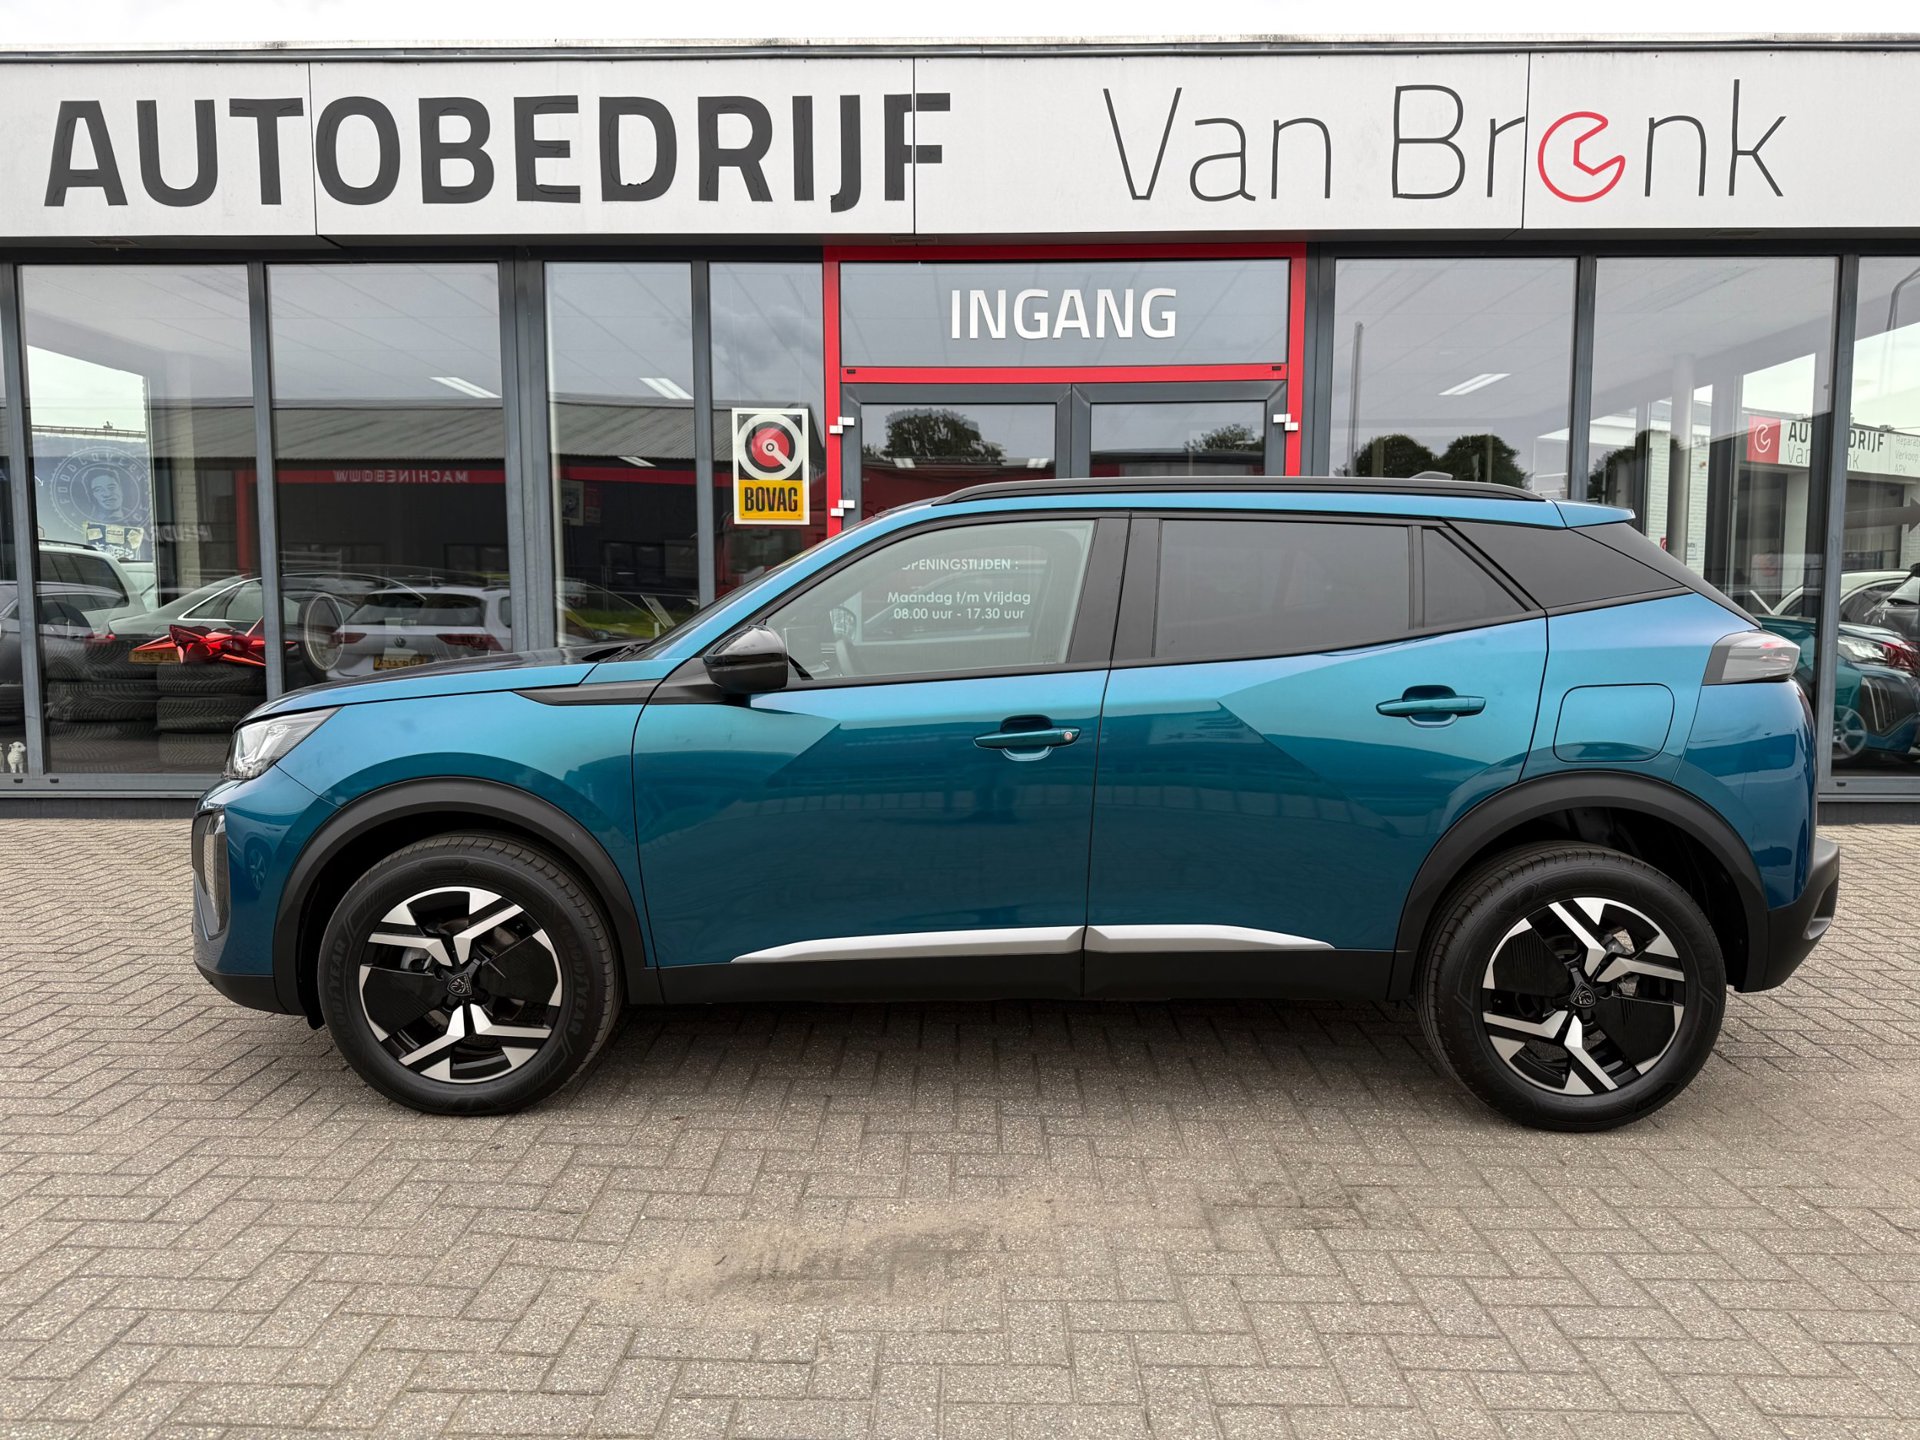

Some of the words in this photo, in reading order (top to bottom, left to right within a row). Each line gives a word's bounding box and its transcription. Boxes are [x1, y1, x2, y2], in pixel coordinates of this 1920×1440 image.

[44, 92, 951, 213] AUTOBEDRIJF
[1103, 86, 1333, 202] Van
[951, 287, 1178, 340] INGANG
[744, 486, 798, 513] BOVAG
[887, 591, 953, 606] Maandag
[956, 591, 980, 605] t/m
[983, 591, 1031, 606] Vrijdag
[893, 607, 929, 620] 08.00
[932, 609, 953, 620] uur
[967, 607, 1000, 620] 17.30
[1003, 609, 1025, 620] uur
